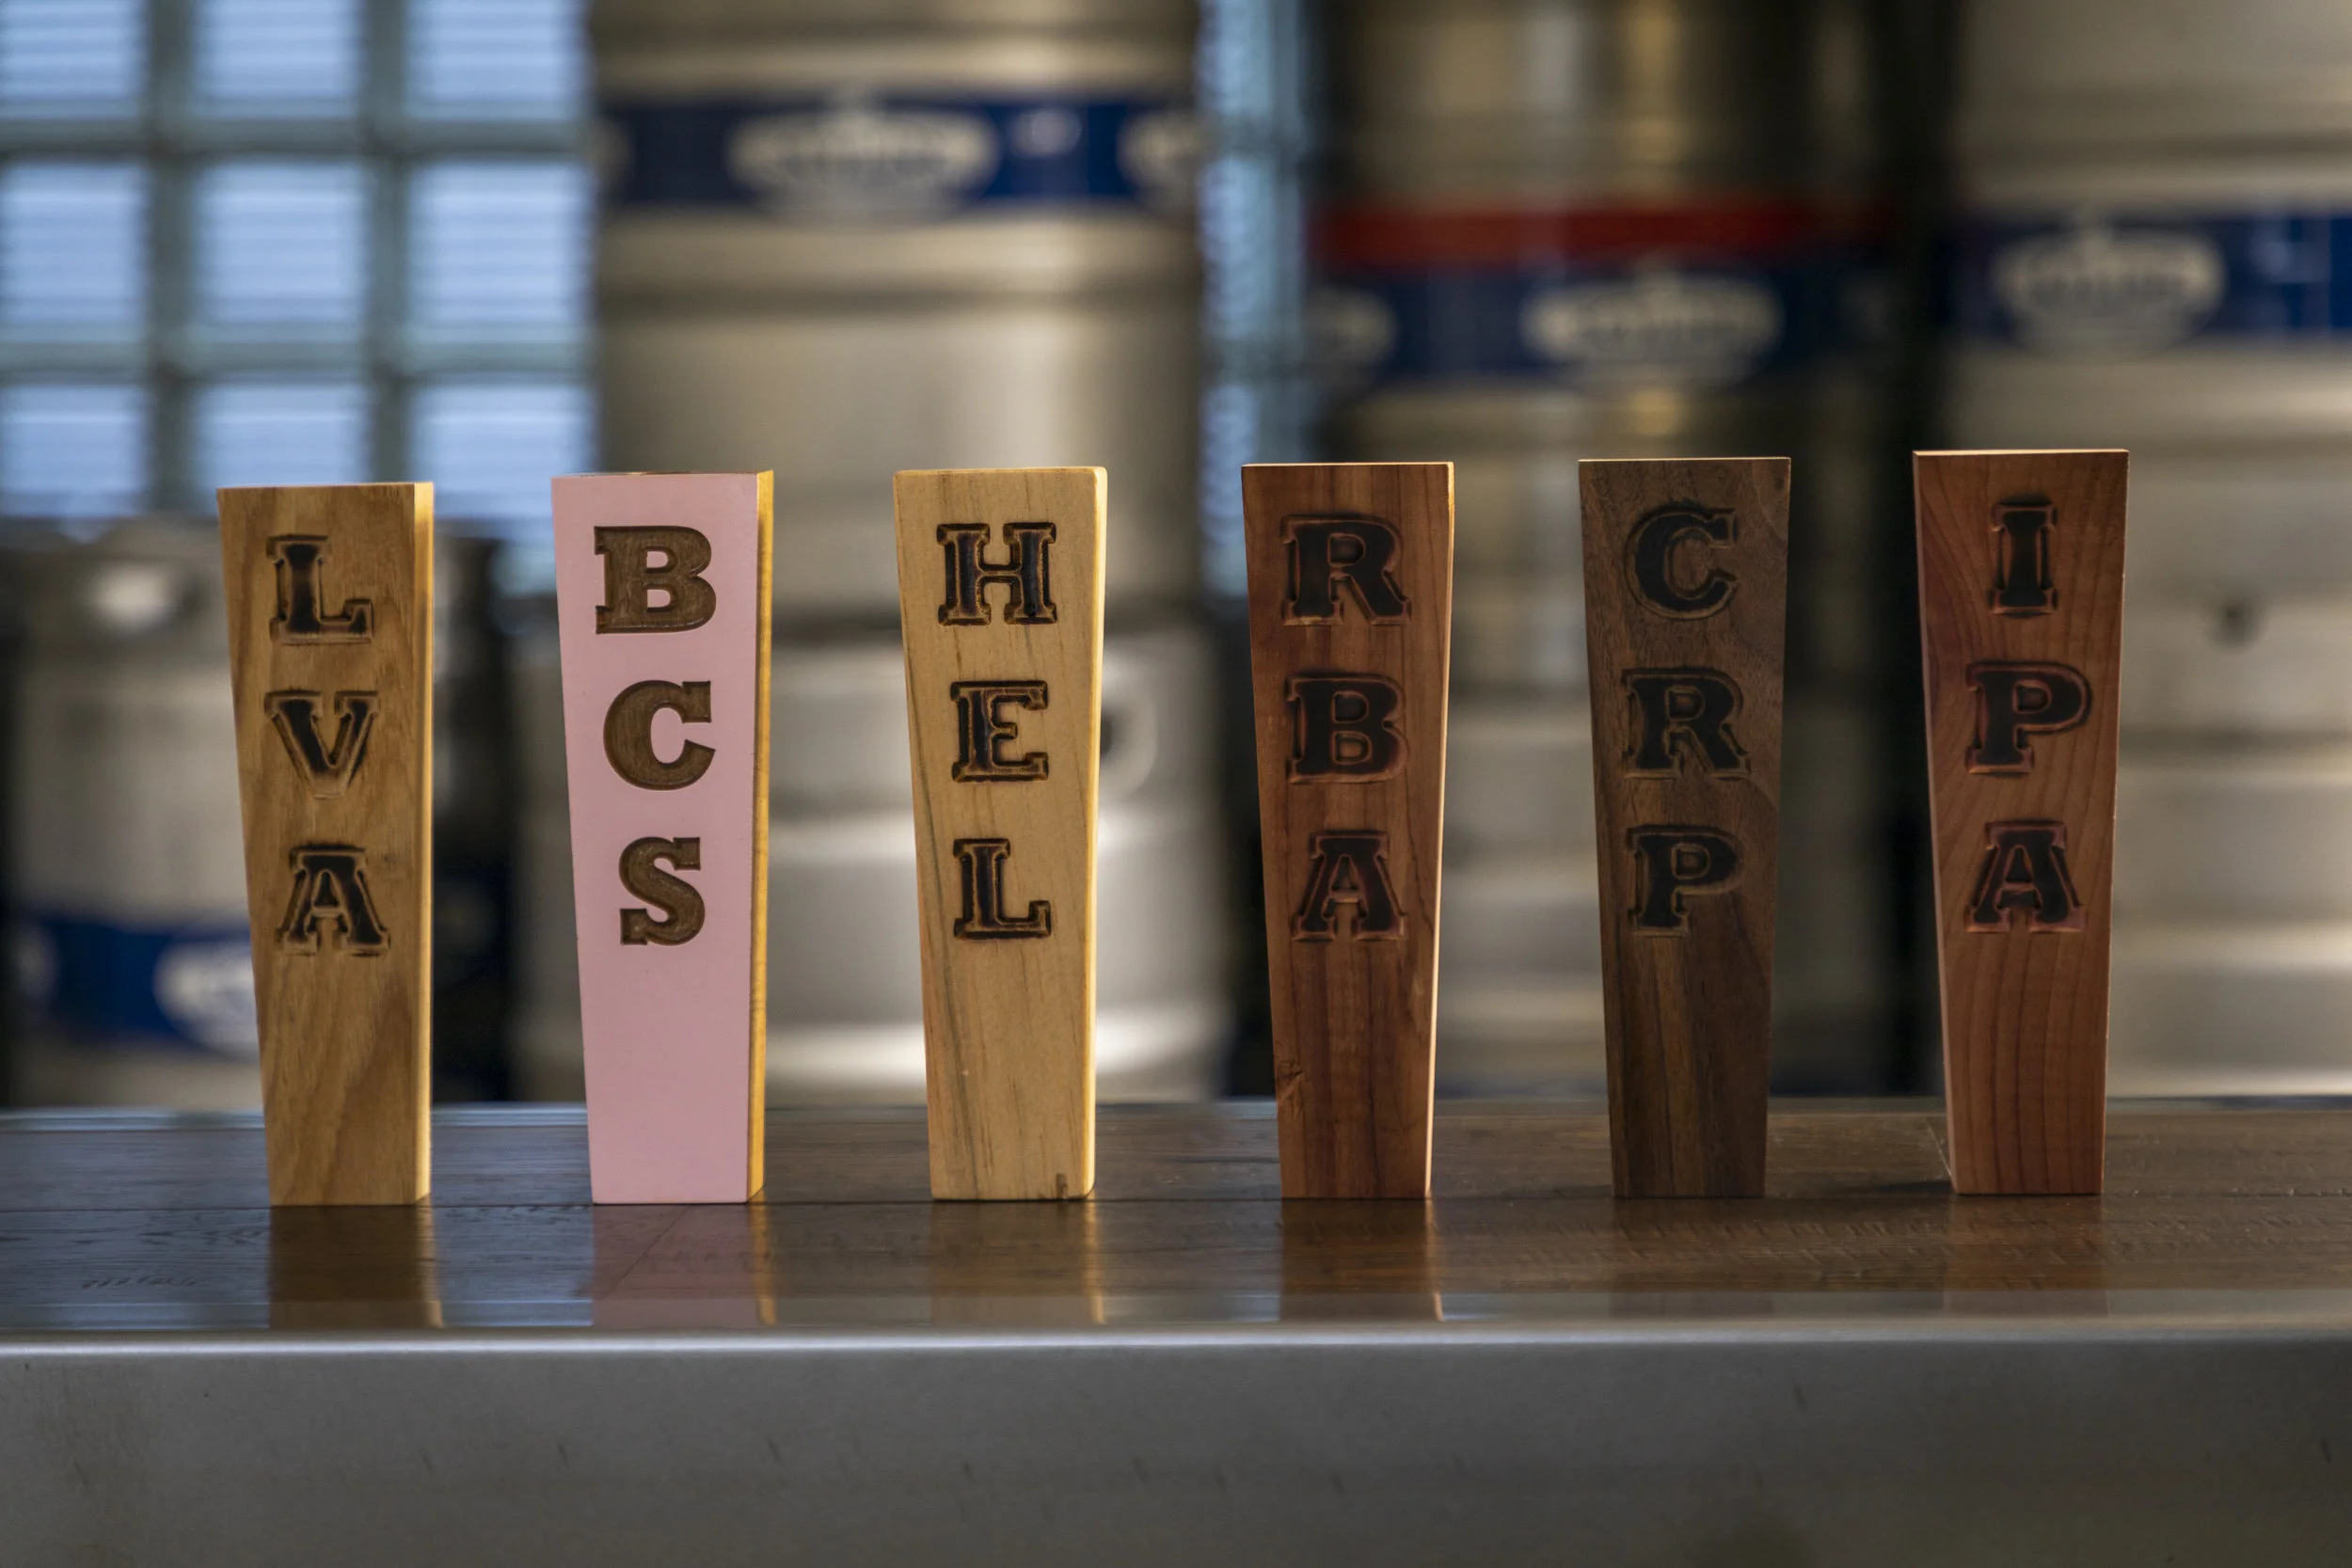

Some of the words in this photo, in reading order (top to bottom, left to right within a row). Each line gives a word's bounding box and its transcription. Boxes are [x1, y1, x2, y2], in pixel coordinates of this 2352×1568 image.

[266, 533, 390, 957] LVA
[594, 525, 717, 946] BCS
[936, 521, 1058, 940] HEL
[1279, 514, 1412, 942] RBA
[1621, 503, 1751, 938] CRP
[1964, 497, 2093, 934] IPA
